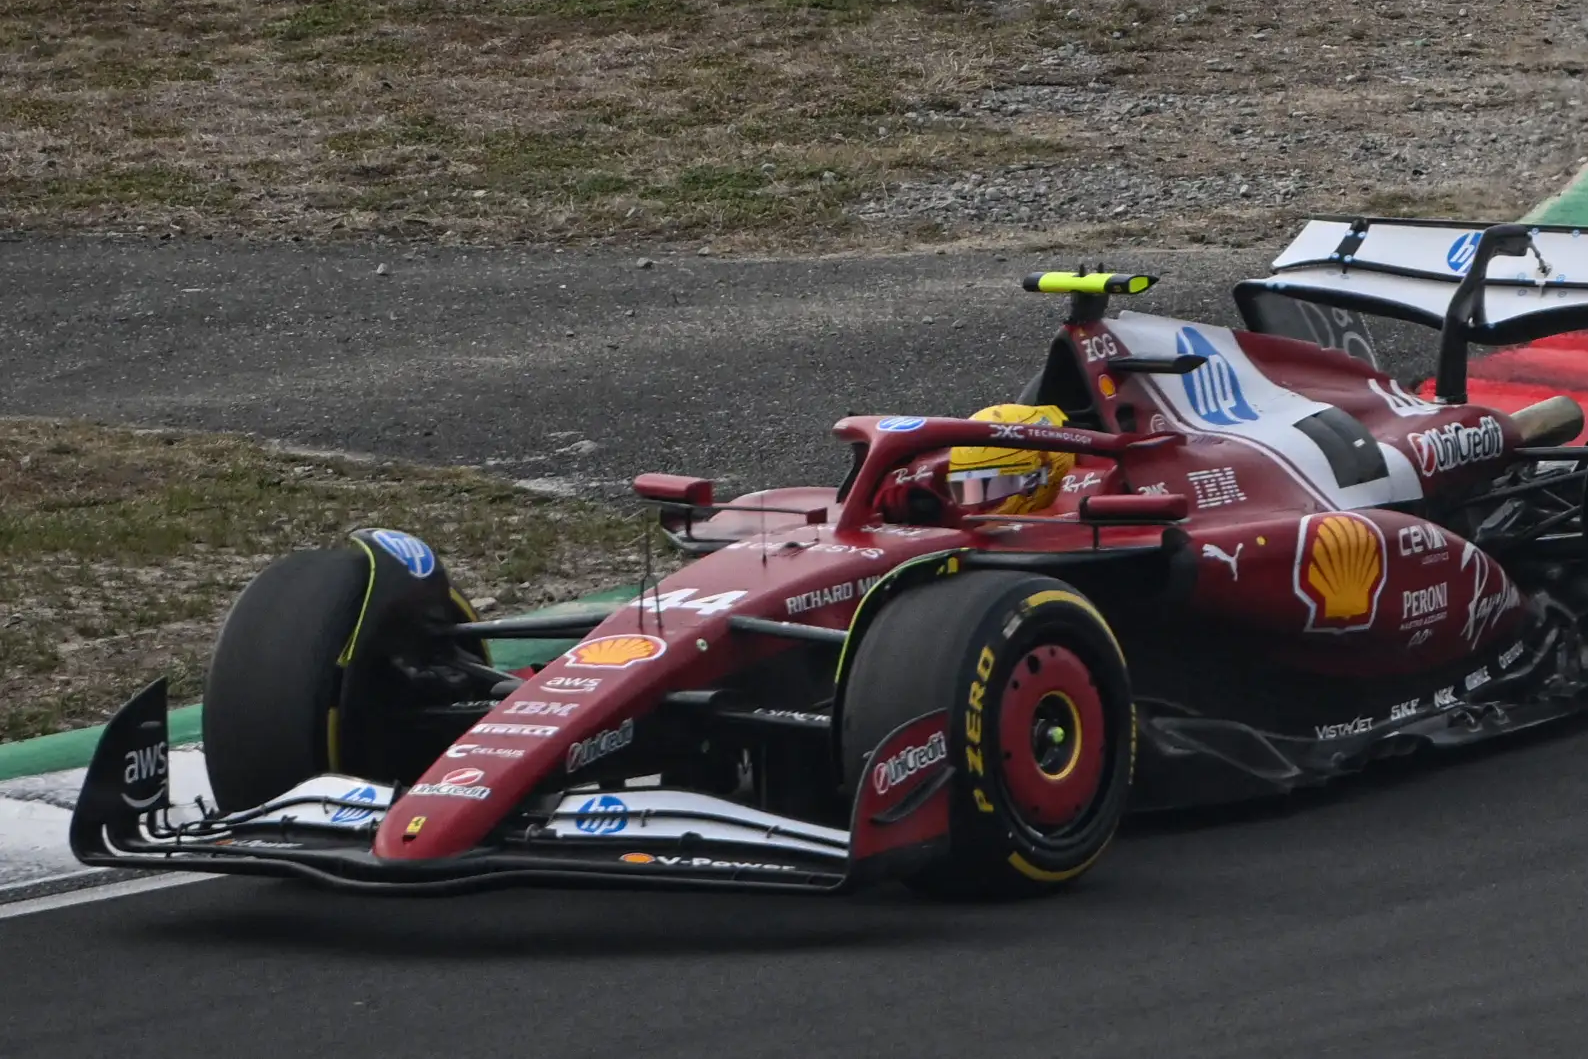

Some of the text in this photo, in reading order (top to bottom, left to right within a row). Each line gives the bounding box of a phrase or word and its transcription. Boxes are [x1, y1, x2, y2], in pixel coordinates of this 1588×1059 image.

[1080, 333, 1118, 363] ZCG
[1177, 327, 1246, 424] hp
[988, 424, 1093, 445] DXC TECHNOLOGY
[1424, 416, 1504, 471] UniCredit
[1187, 467, 1247, 509] IBM
[376, 530, 427, 576] hp
[630, 587, 749, 615] 44
[785, 582, 853, 615] RICHARD
[1402, 582, 1448, 619] PERONI
[546, 676, 603, 687] aws
[503, 700, 581, 717] IBM
[1390, 698, 1420, 721] SKF
[471, 723, 560, 737] PIRELLI
[965, 644, 996, 813] P ZERO
[124, 740, 169, 784] aws
[470, 745, 526, 756] CELSIUS
[887, 730, 948, 785] UniCredit
[332, 786, 375, 822] hp
[407, 783, 491, 800] UniCredit
[578, 795, 628, 835] hp
[656, 855, 797, 872] V-Power
